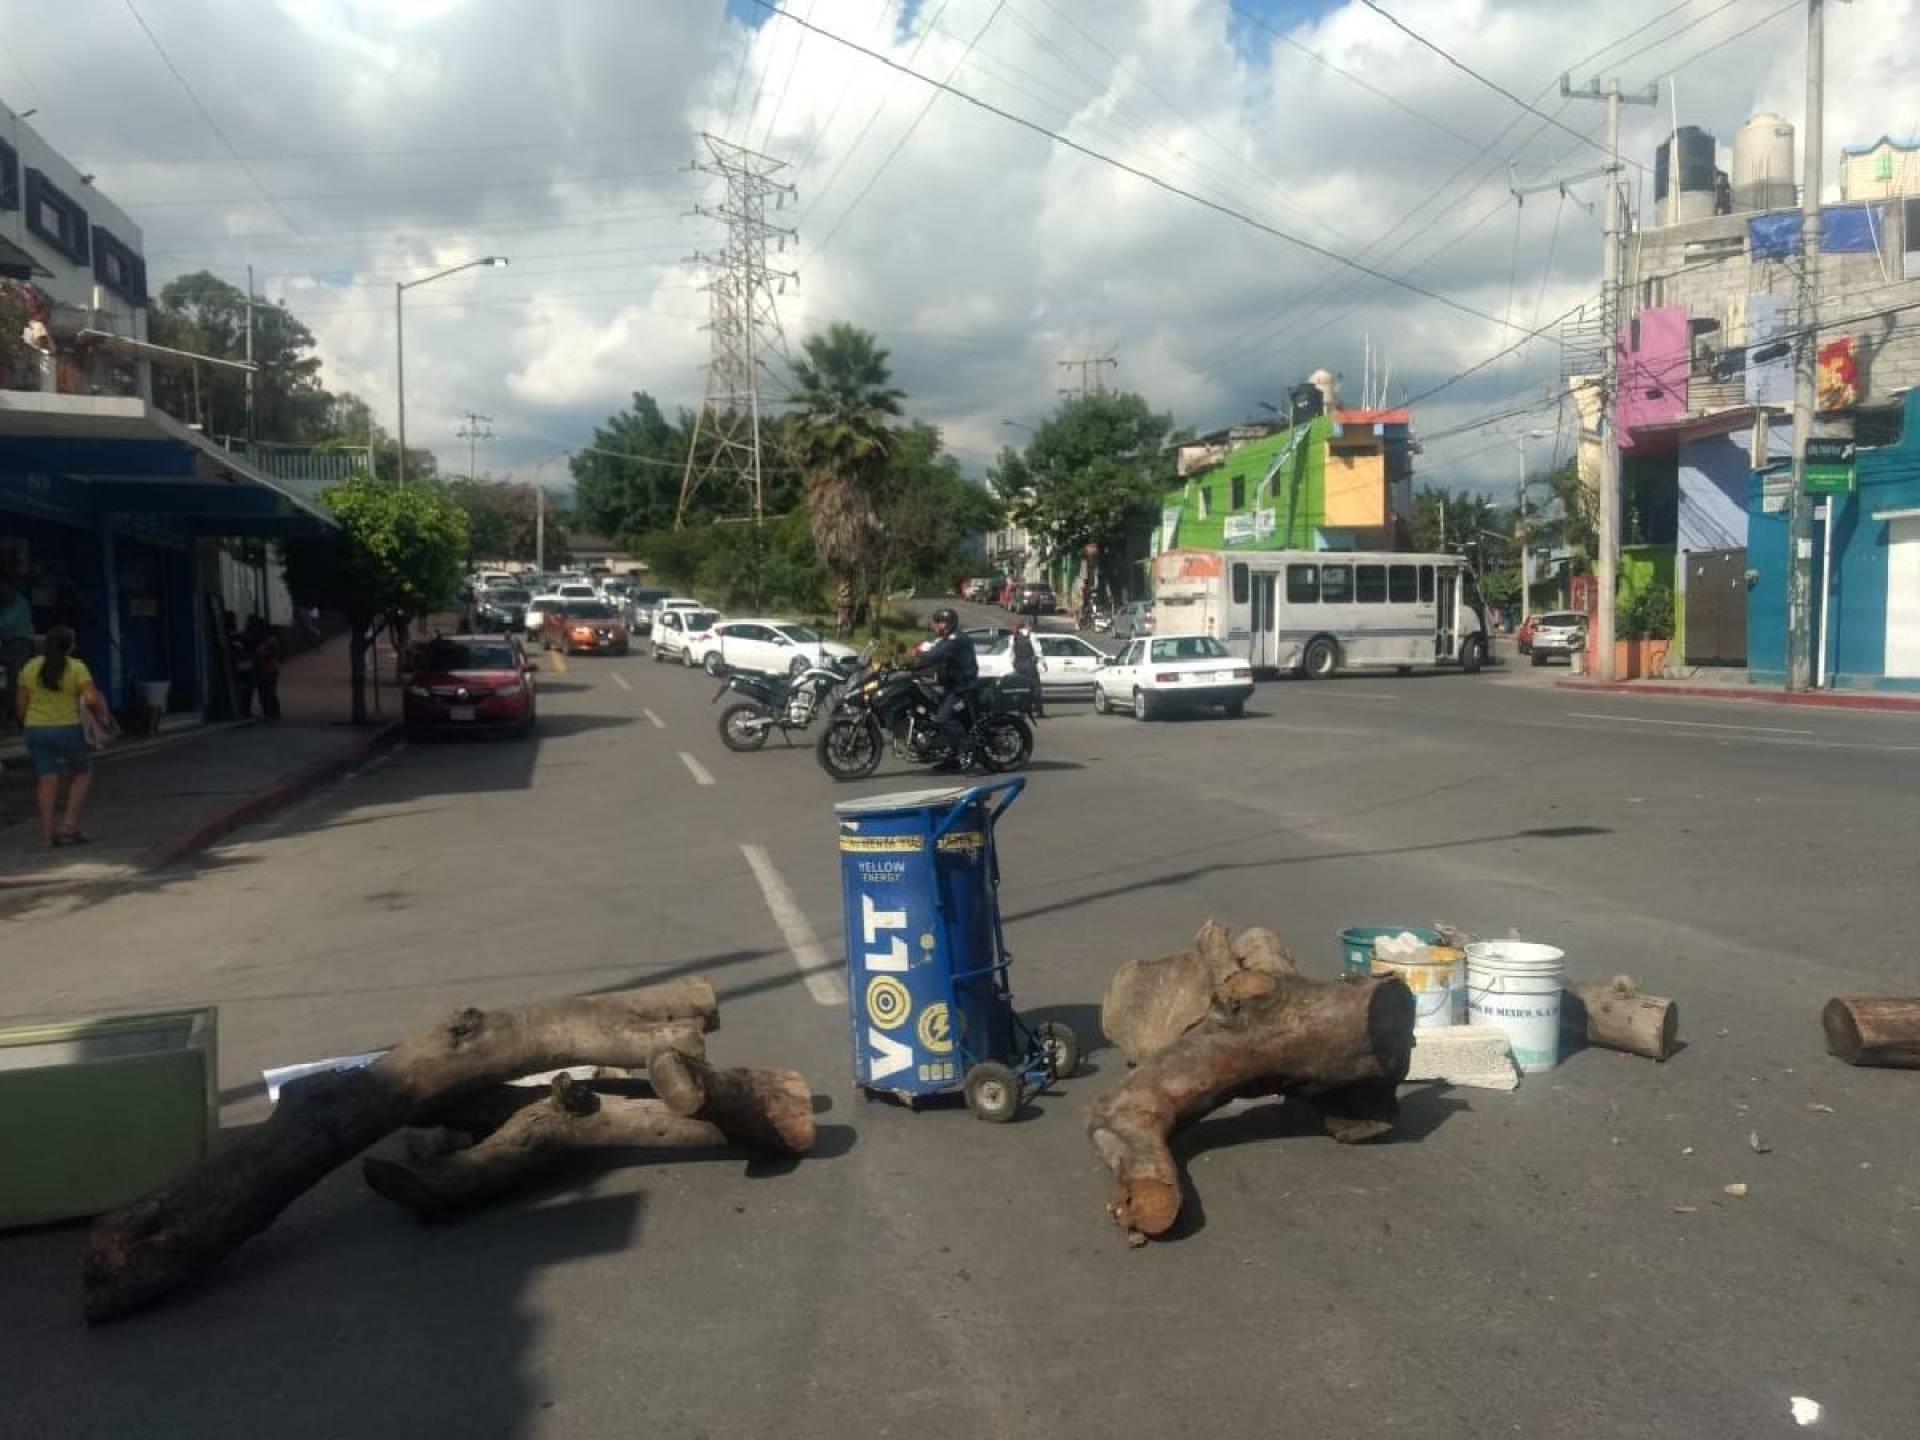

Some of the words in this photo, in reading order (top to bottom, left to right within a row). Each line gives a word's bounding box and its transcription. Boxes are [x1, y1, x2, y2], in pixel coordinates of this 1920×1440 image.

[859, 861, 905, 873] YELLOW
[862, 873, 901, 882] ENERGY
[861, 893, 913, 1082] VOLT
